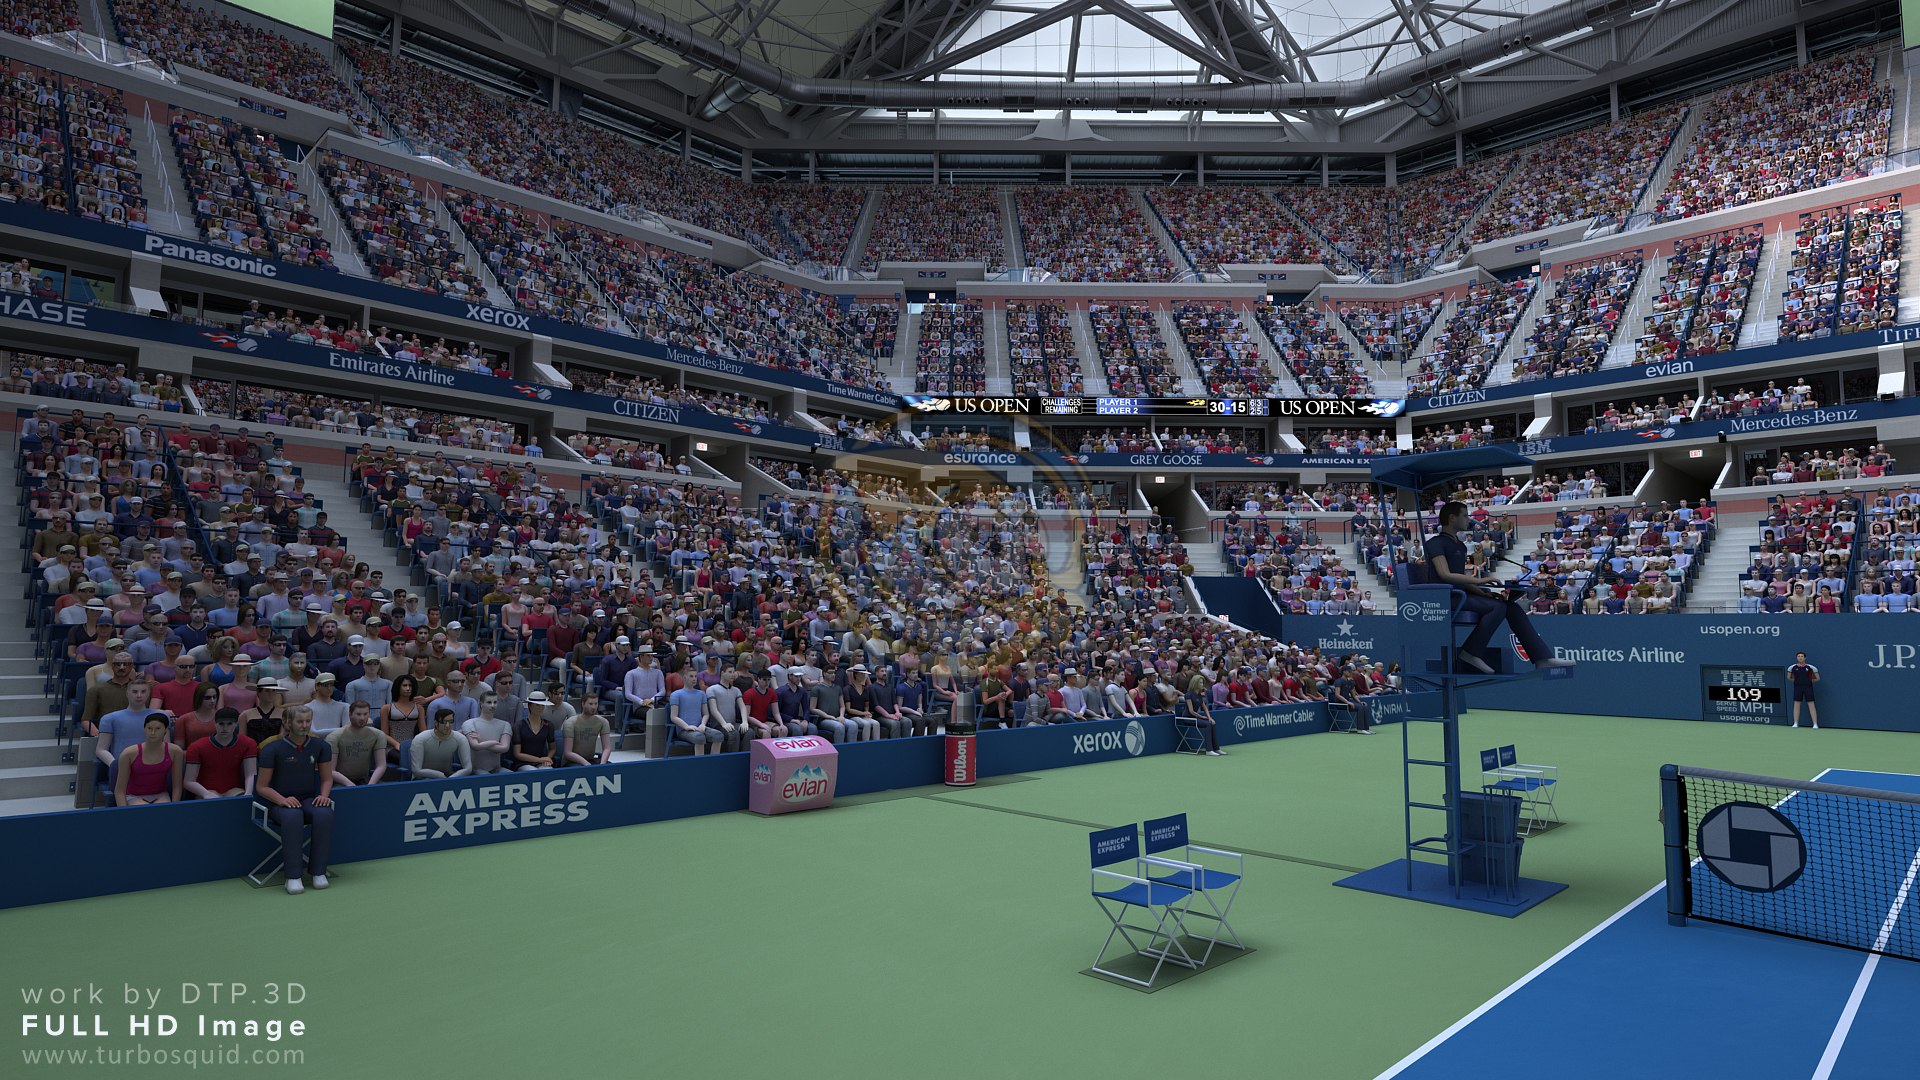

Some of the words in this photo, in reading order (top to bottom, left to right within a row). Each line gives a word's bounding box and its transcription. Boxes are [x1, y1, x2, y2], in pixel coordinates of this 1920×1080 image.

[145, 234, 277, 277] Panasonic
[465, 303, 530, 331] xerox
[329, 352, 401, 377] Emirates
[405, 363, 455, 386] Airline
[665, 348, 744, 375] Mercedes-Benz
[1646, 358, 1693, 378] evian
[827, 382, 846, 396] Time
[846, 386, 875, 402] Warner
[875, 391, 896, 406] Cable
[1428, 389, 1486, 409] CITIZEN
[955, 398, 977, 413] US
[980, 398, 1030, 413] OPEN
[1042, 398, 1081, 406] CHALLENGES
[1209, 401, 1246, 413] 30-15
[1280, 400, 1301, 415] US
[1306, 400, 1355, 415] OPEN
[613, 399, 680, 424] CITIZEN
[1045, 406, 1079, 414] REMAINING
[1730, 408, 1858, 433] Mercedes-Benz
[818, 433, 844, 451] IBM
[1518, 439, 1552, 456] IBM
[944, 452, 1017, 464] esurance
[1131, 454, 1159, 465] GREY
[1162, 454, 1202, 465] GOOSE
[1422, 601, 1441, 609] Time
[1700, 625, 1780, 637] usopen.org
[1318, 638, 1374, 650] Heineken
[1553, 646, 1624, 662] Emirates
[1628, 646, 1685, 663] Airline
[1720, 669, 1766, 687] IBM
[1727, 687, 1762, 701] 109
[1383, 702, 1411, 716] NIRML
[1740, 702, 1773, 713] MPH
[1244, 714, 1265, 729] Time
[1265, 711, 1292, 726] Warner
[1293, 709, 1313, 723] Cable
[1720, 714, 1770, 723] usopen.org
[774, 739, 823, 750] evian
[1073, 731, 1122, 754] xerox
[953, 738, 967, 783] Wilson
[753, 770, 771, 783] evian
[405, 774, 622, 817] AMERICAN
[783, 778, 828, 799] evian
[404, 800, 589, 842] EXPRESS
[1151, 824, 1181, 836] AMERICAN
[1151, 831, 1176, 842] EXPRESS
[1097, 835, 1131, 848] AMERICAN
[1097, 842, 1125, 855] EXPRESS
